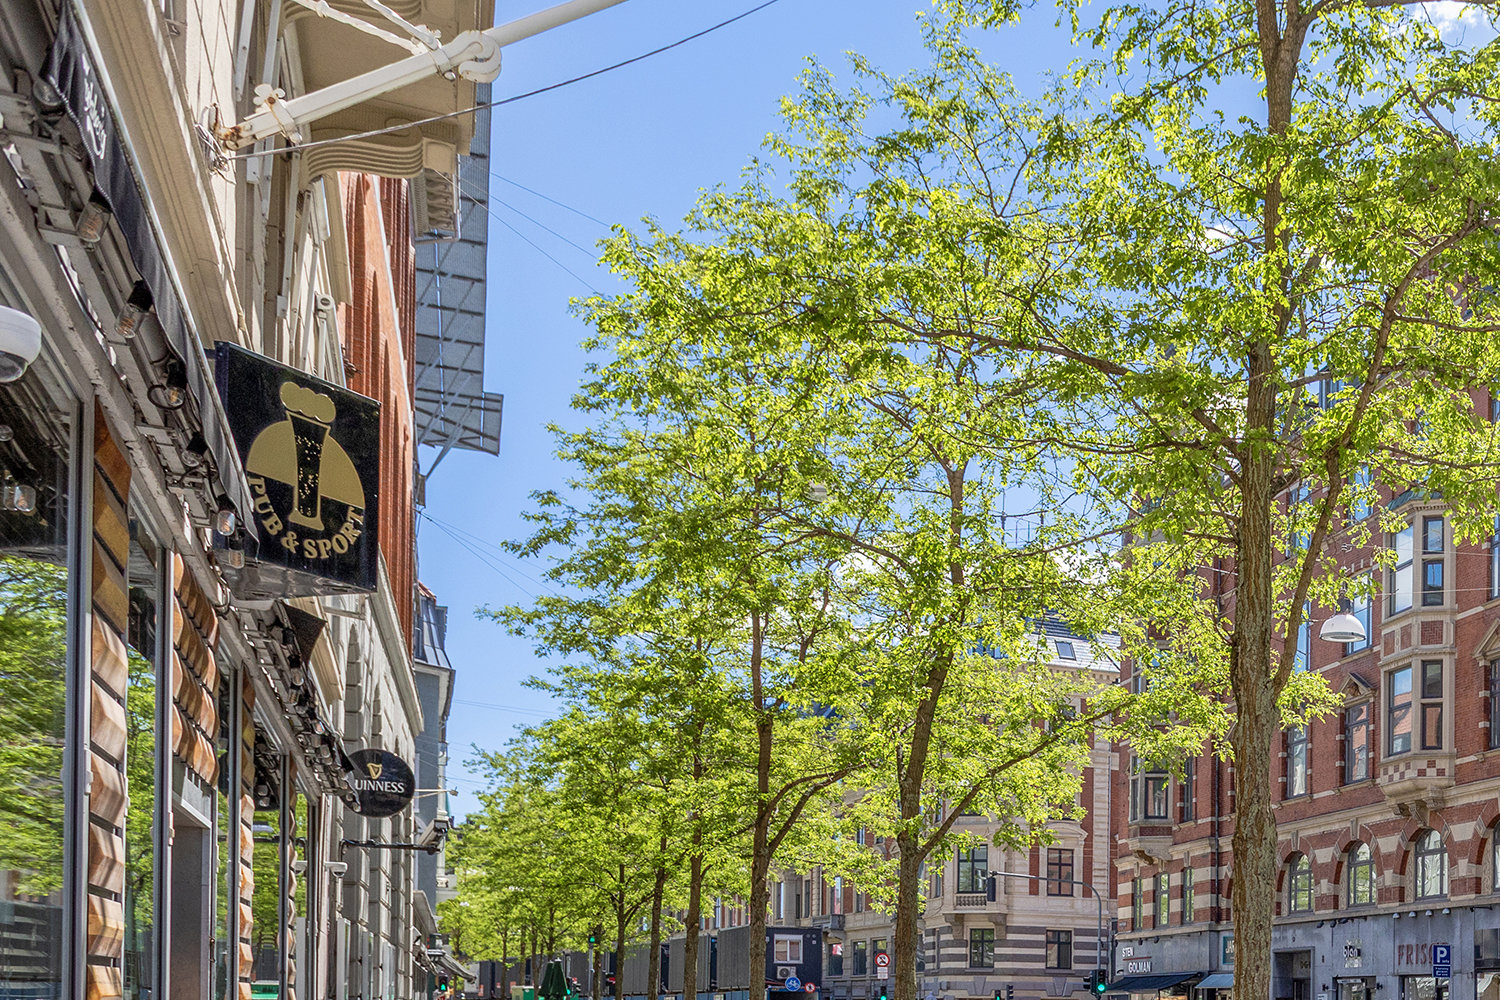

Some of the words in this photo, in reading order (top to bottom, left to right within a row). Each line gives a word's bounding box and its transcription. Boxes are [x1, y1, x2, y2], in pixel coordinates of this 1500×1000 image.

[247, 477, 283, 535] PUB
[281, 531, 299, 553] &
[303, 506, 364, 558] SPORT
[355, 780, 404, 793] UINNESS
[1122, 947, 1134, 957] STEN
[1437, 947, 1447, 963] P
[1128, 962, 1151, 973] GOLMAN
